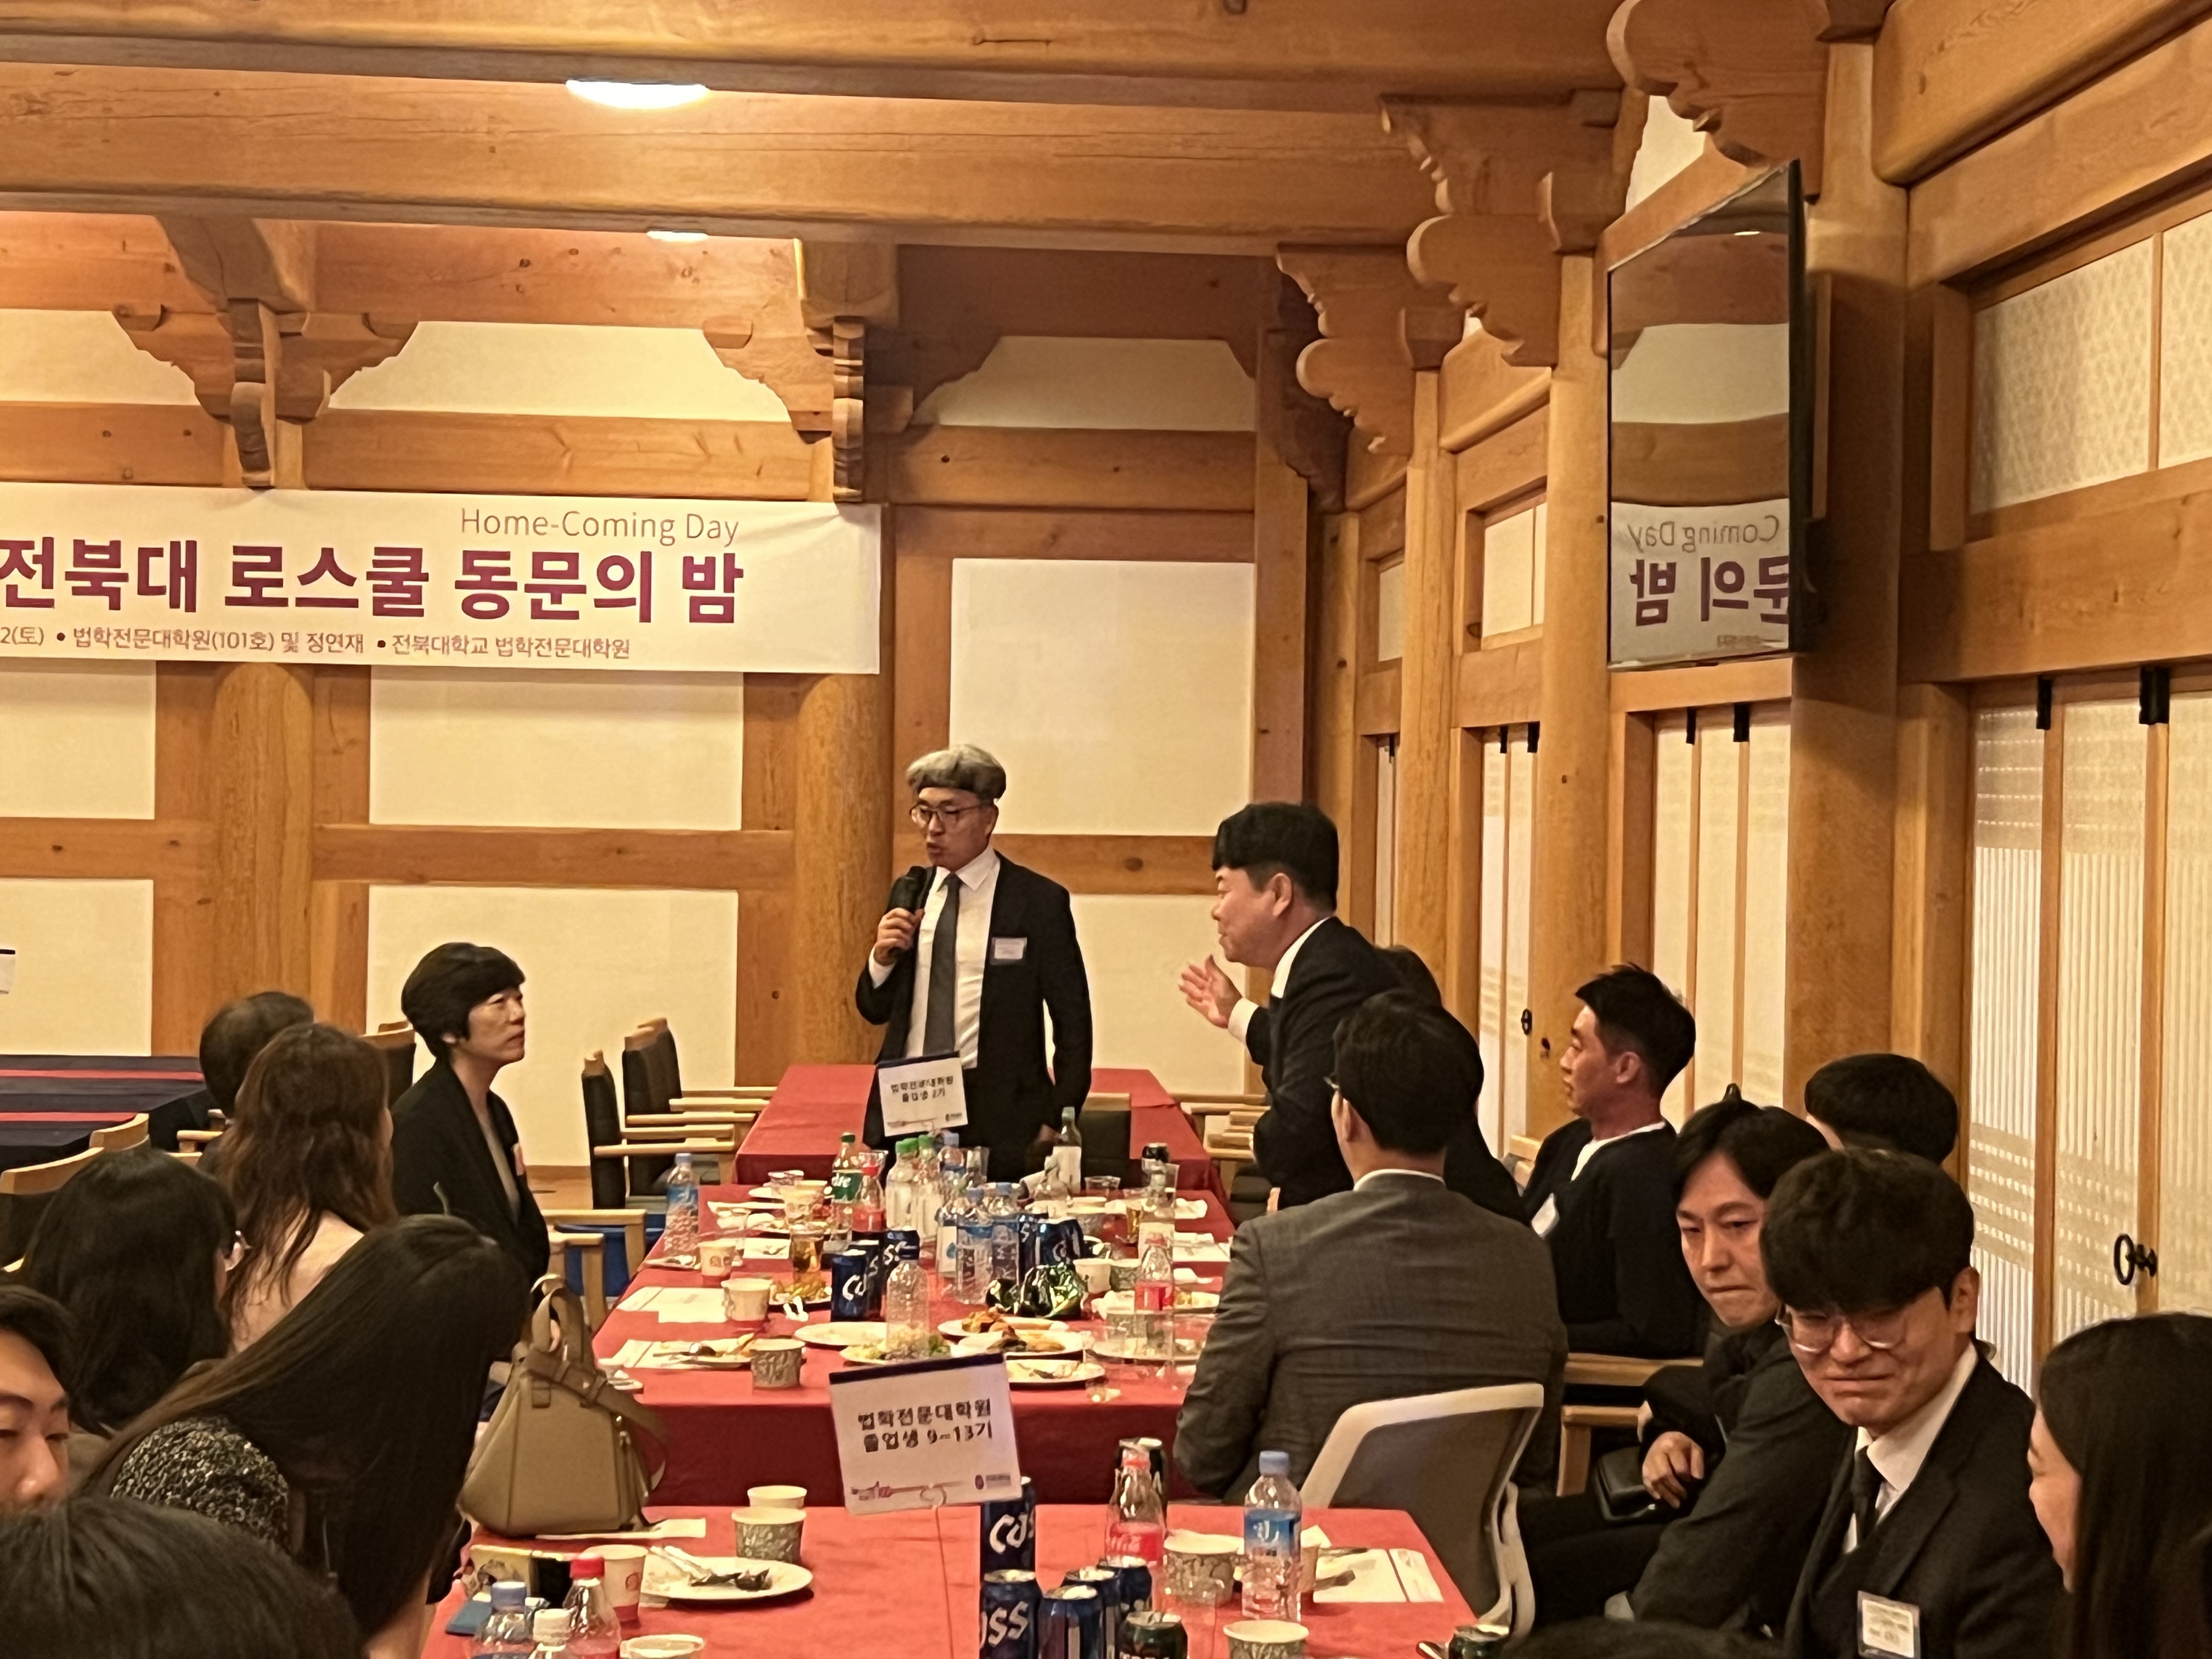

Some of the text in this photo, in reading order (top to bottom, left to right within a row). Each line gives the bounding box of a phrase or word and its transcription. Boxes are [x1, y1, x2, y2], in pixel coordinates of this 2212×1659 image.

[461, 507, 739, 548] Home-Coming Day
[0, 536, 744, 623] 전북대 로스쿨 동문의 밤
[74, 627, 275, 652] 법학전문대학원(101호)
[281, 632, 300, 654] 및
[307, 632, 364, 654] 정연재
[391, 634, 489, 656] 전북대학교
[495, 637, 630, 660] 법학전문대학원
[858, 1397, 991, 1431] 법학전문대학원
